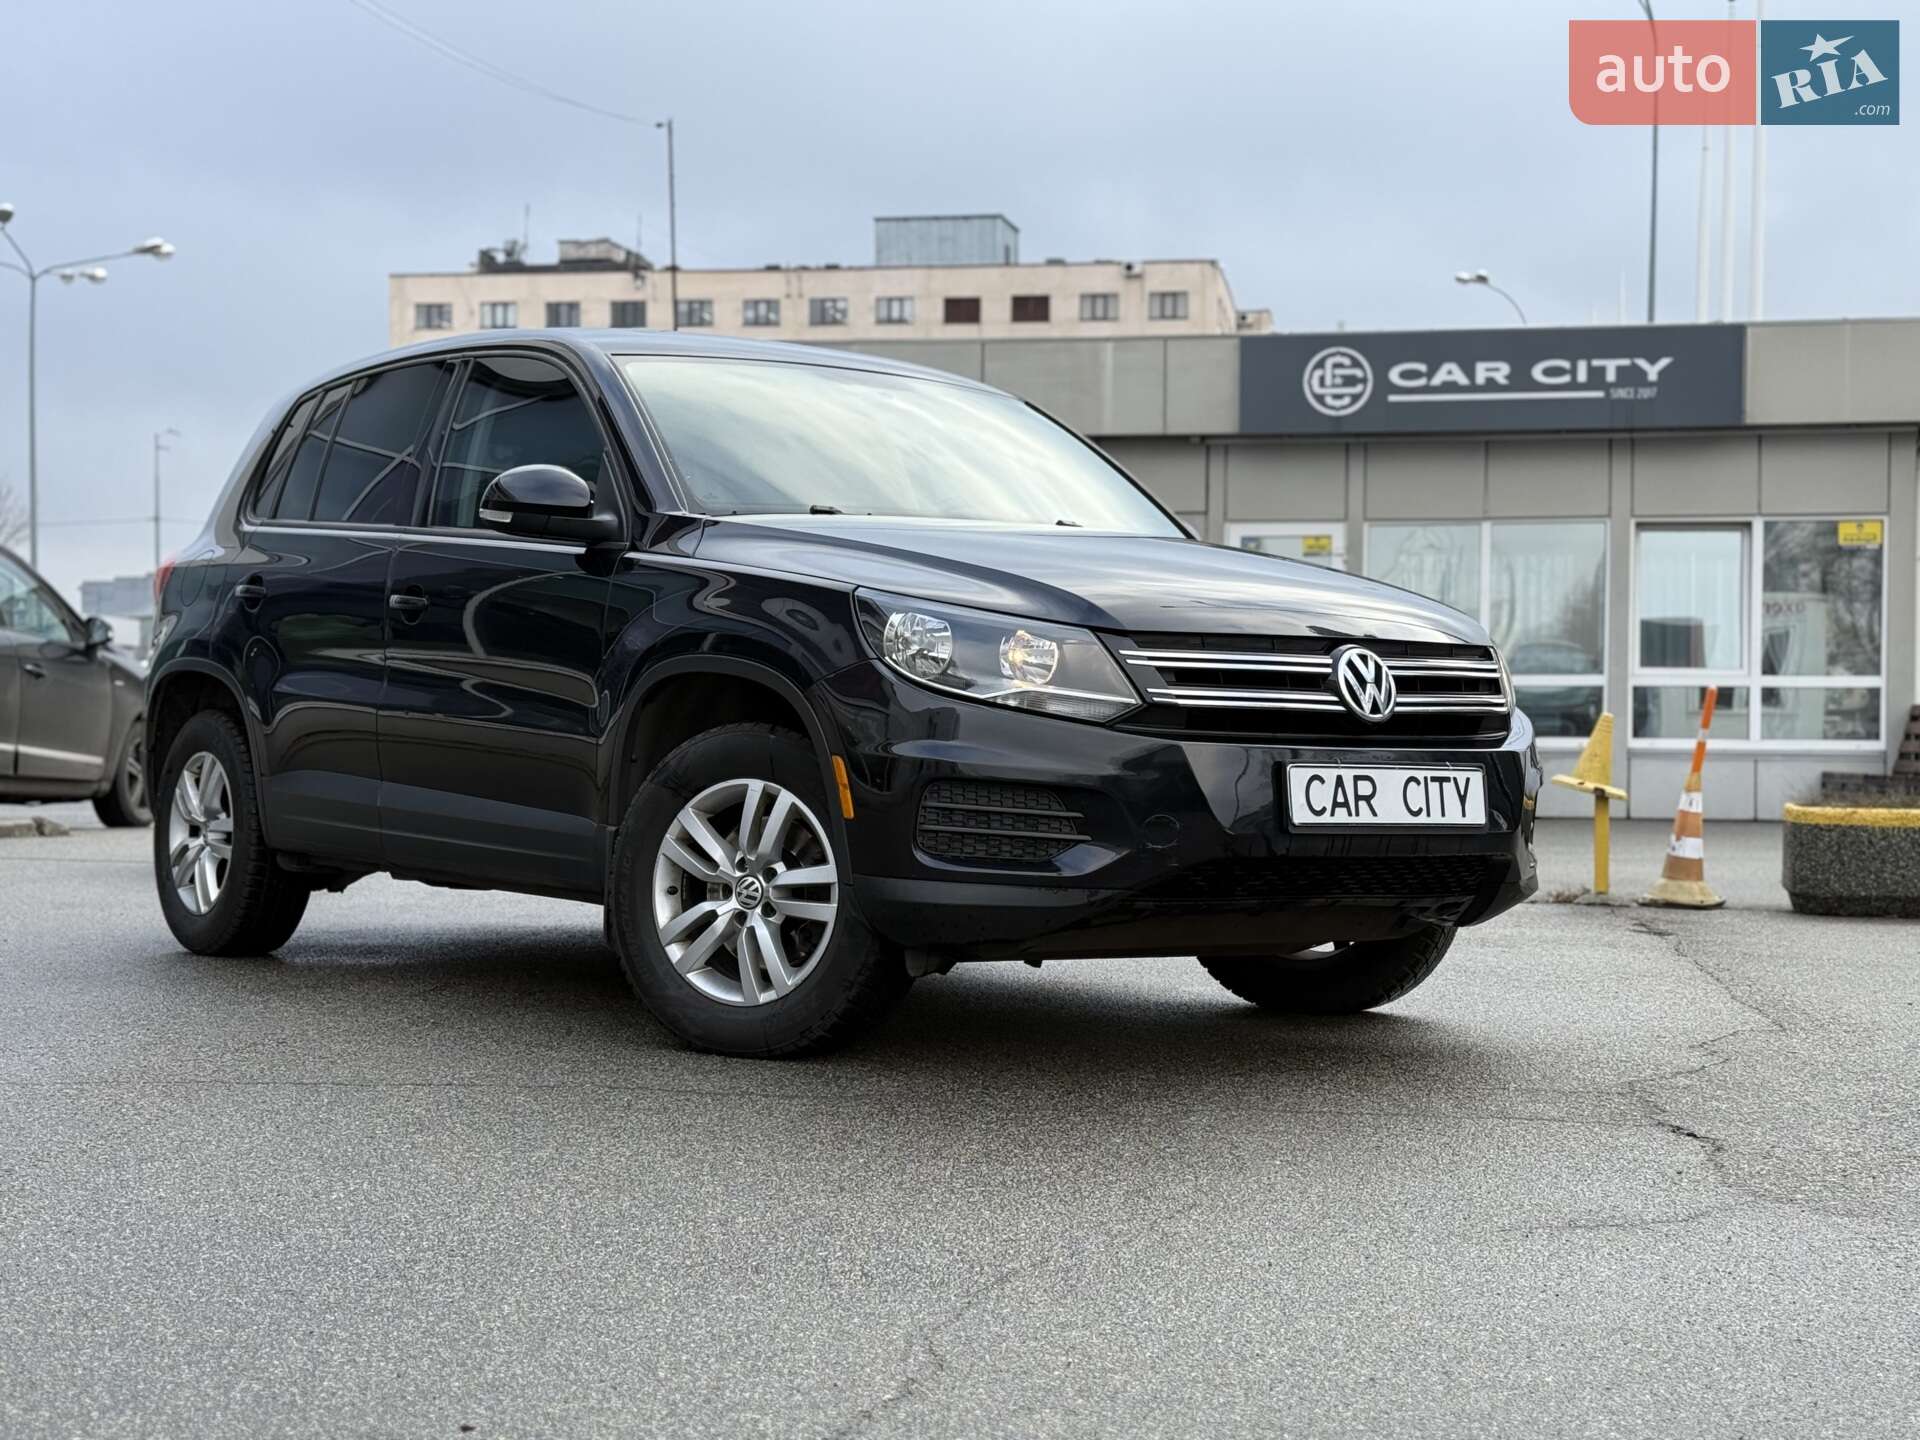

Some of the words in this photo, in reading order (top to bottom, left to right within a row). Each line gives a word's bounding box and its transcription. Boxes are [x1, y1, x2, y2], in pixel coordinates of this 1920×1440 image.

[1388, 361, 1511, 388] CAR
[1531, 357, 1674, 385] CITY
[1305, 774, 1378, 817] CAR
[1402, 776, 1471, 818] CITY
